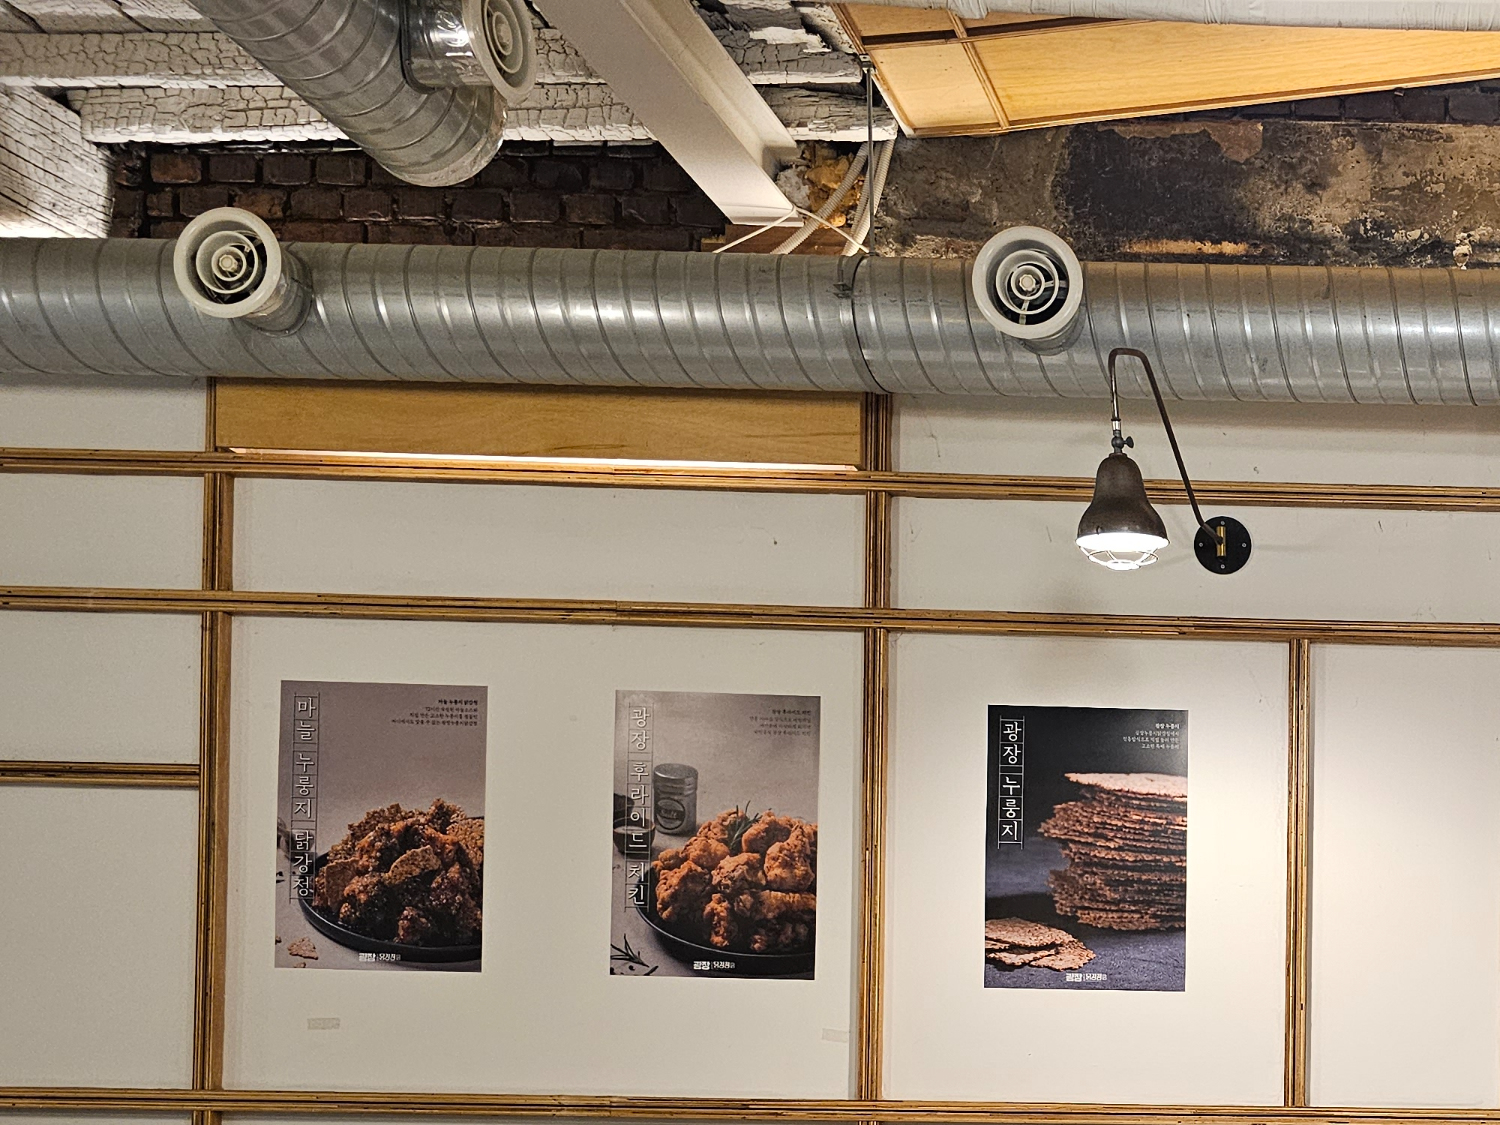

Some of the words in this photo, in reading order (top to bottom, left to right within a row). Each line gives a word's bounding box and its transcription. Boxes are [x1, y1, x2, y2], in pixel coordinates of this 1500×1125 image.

[296, 698, 317, 740] 마늘
[630, 708, 650, 750] 광장
[1002, 722, 1022, 765] 광장
[294, 753, 315, 819] 누룽지
[628, 762, 649, 848] 후라이드
[1001, 777, 1021, 841] 누룽지
[292, 830, 314, 897] 닭강정
[628, 862, 646, 905] 치킨
